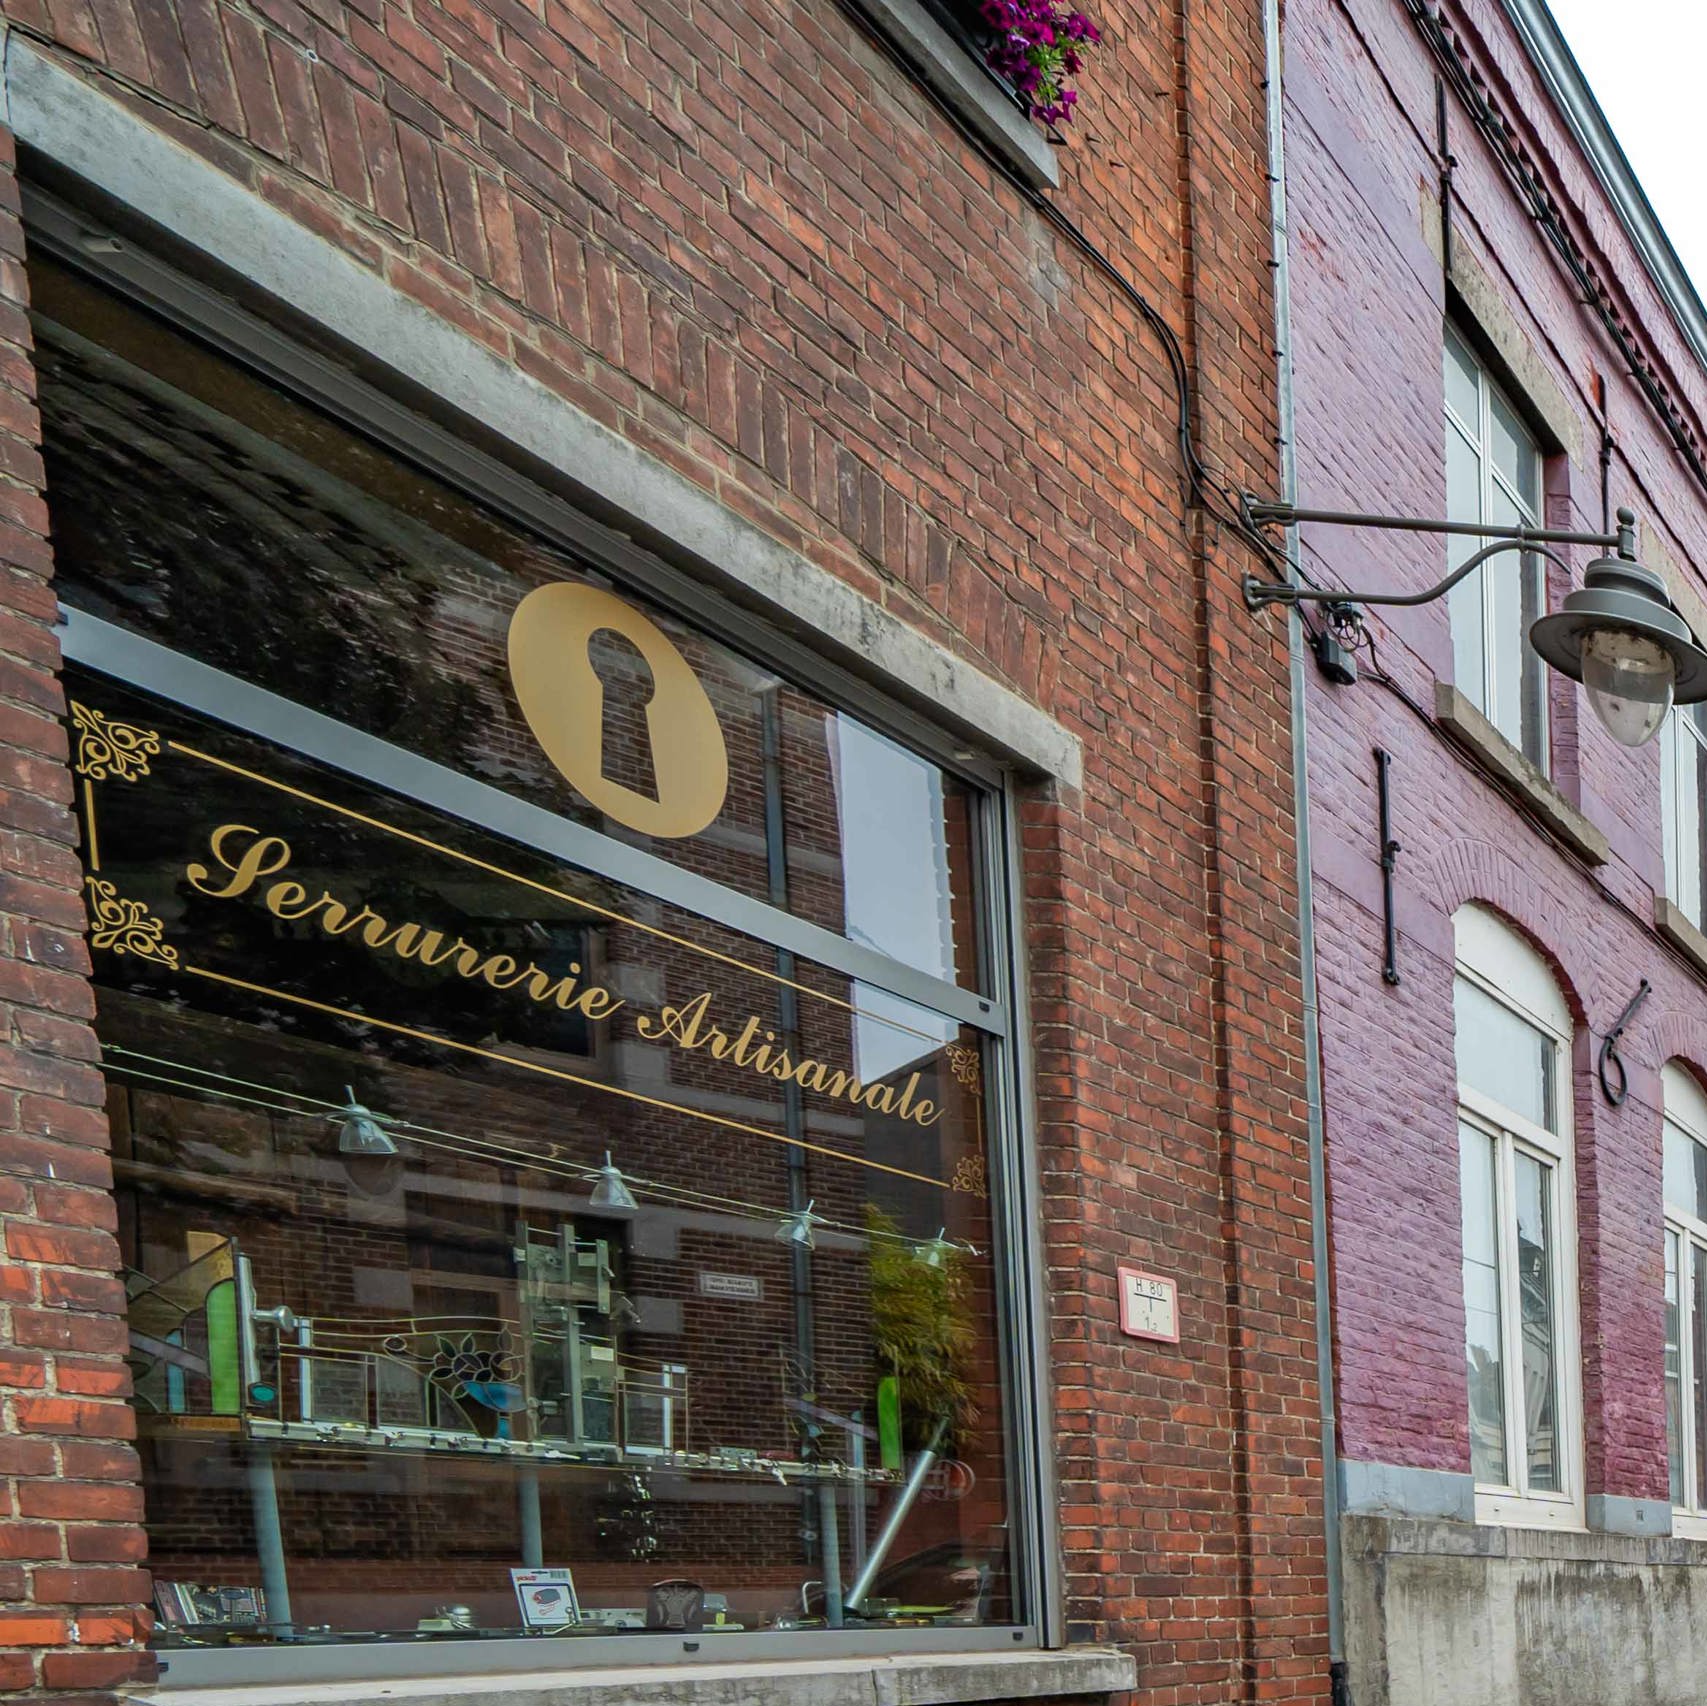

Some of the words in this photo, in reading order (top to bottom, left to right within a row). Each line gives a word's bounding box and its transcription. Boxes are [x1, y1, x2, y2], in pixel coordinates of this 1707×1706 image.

[186, 823, 626, 1020] Serrurerie
[636, 991, 946, 1127] Artisanale
[1135, 1278, 1143, 1293] H
[1149, 1281, 1163, 1297] 80
